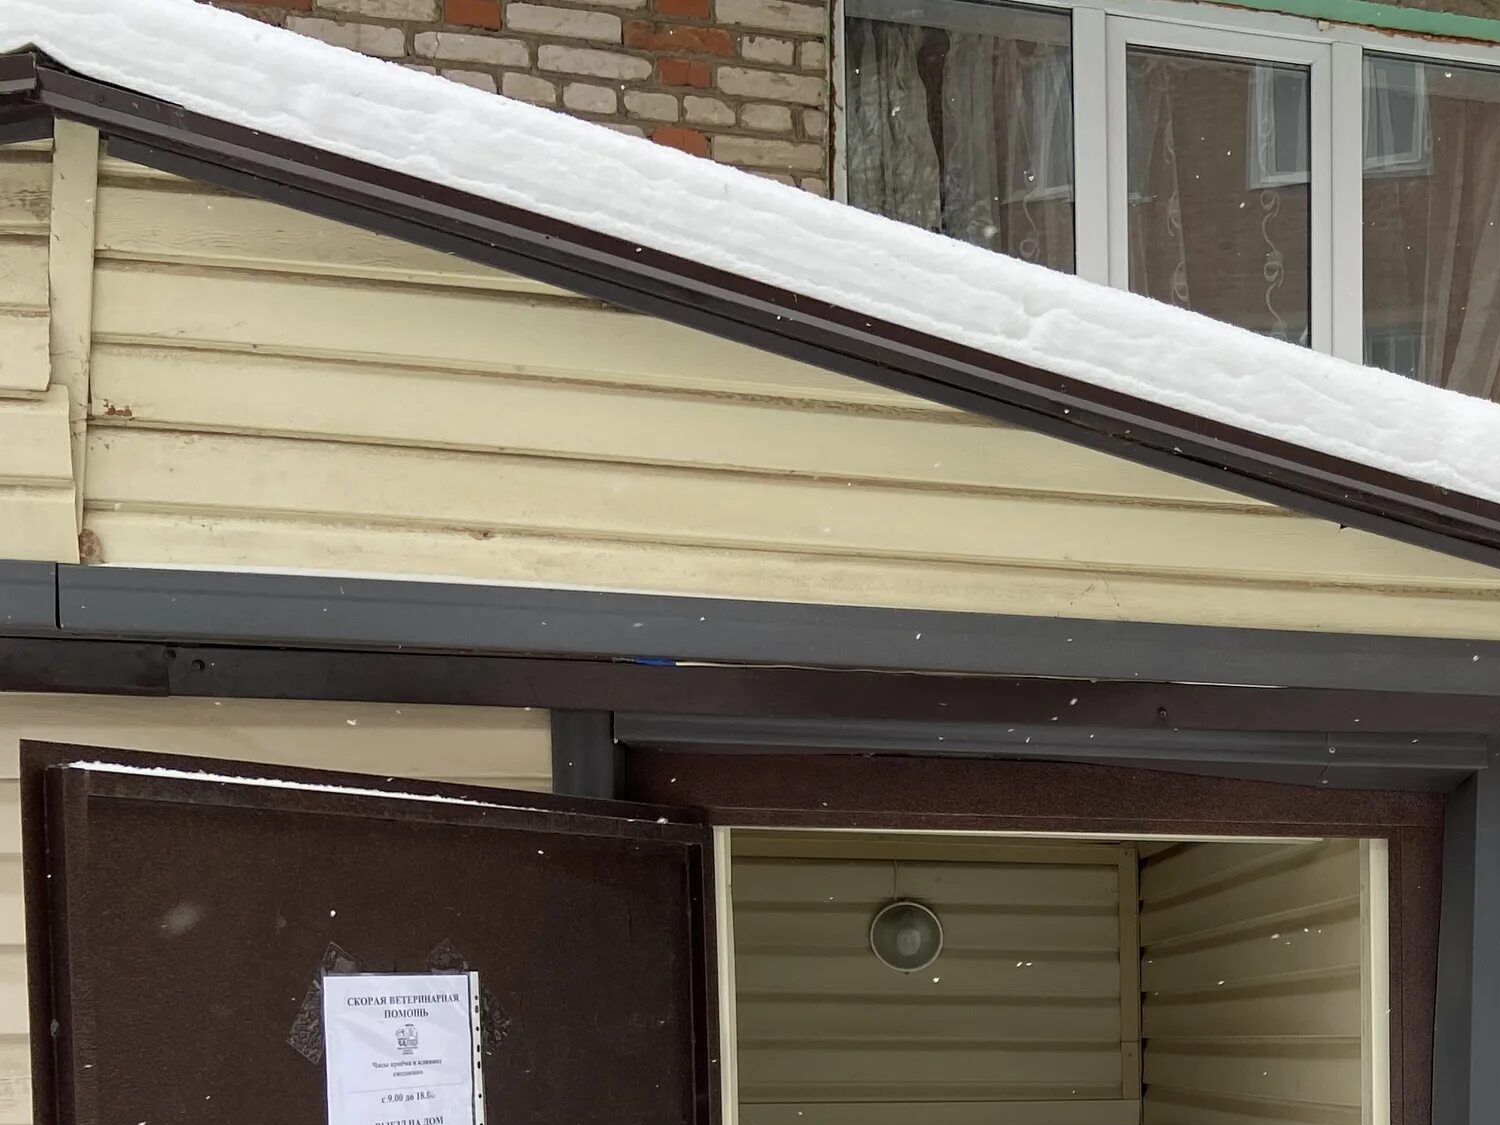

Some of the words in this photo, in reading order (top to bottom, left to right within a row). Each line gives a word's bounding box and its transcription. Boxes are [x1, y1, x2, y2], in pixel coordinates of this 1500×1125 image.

[347, 996, 387, 1007] СКОРАЯ
[389, 994, 460, 1005] ВЕТЕРИНАРНАЯ
[384, 1008, 429, 1019] ПОМОЩЬ
[387, 1093, 404, 1103] 9.00
[404, 1094, 415, 1102] до
